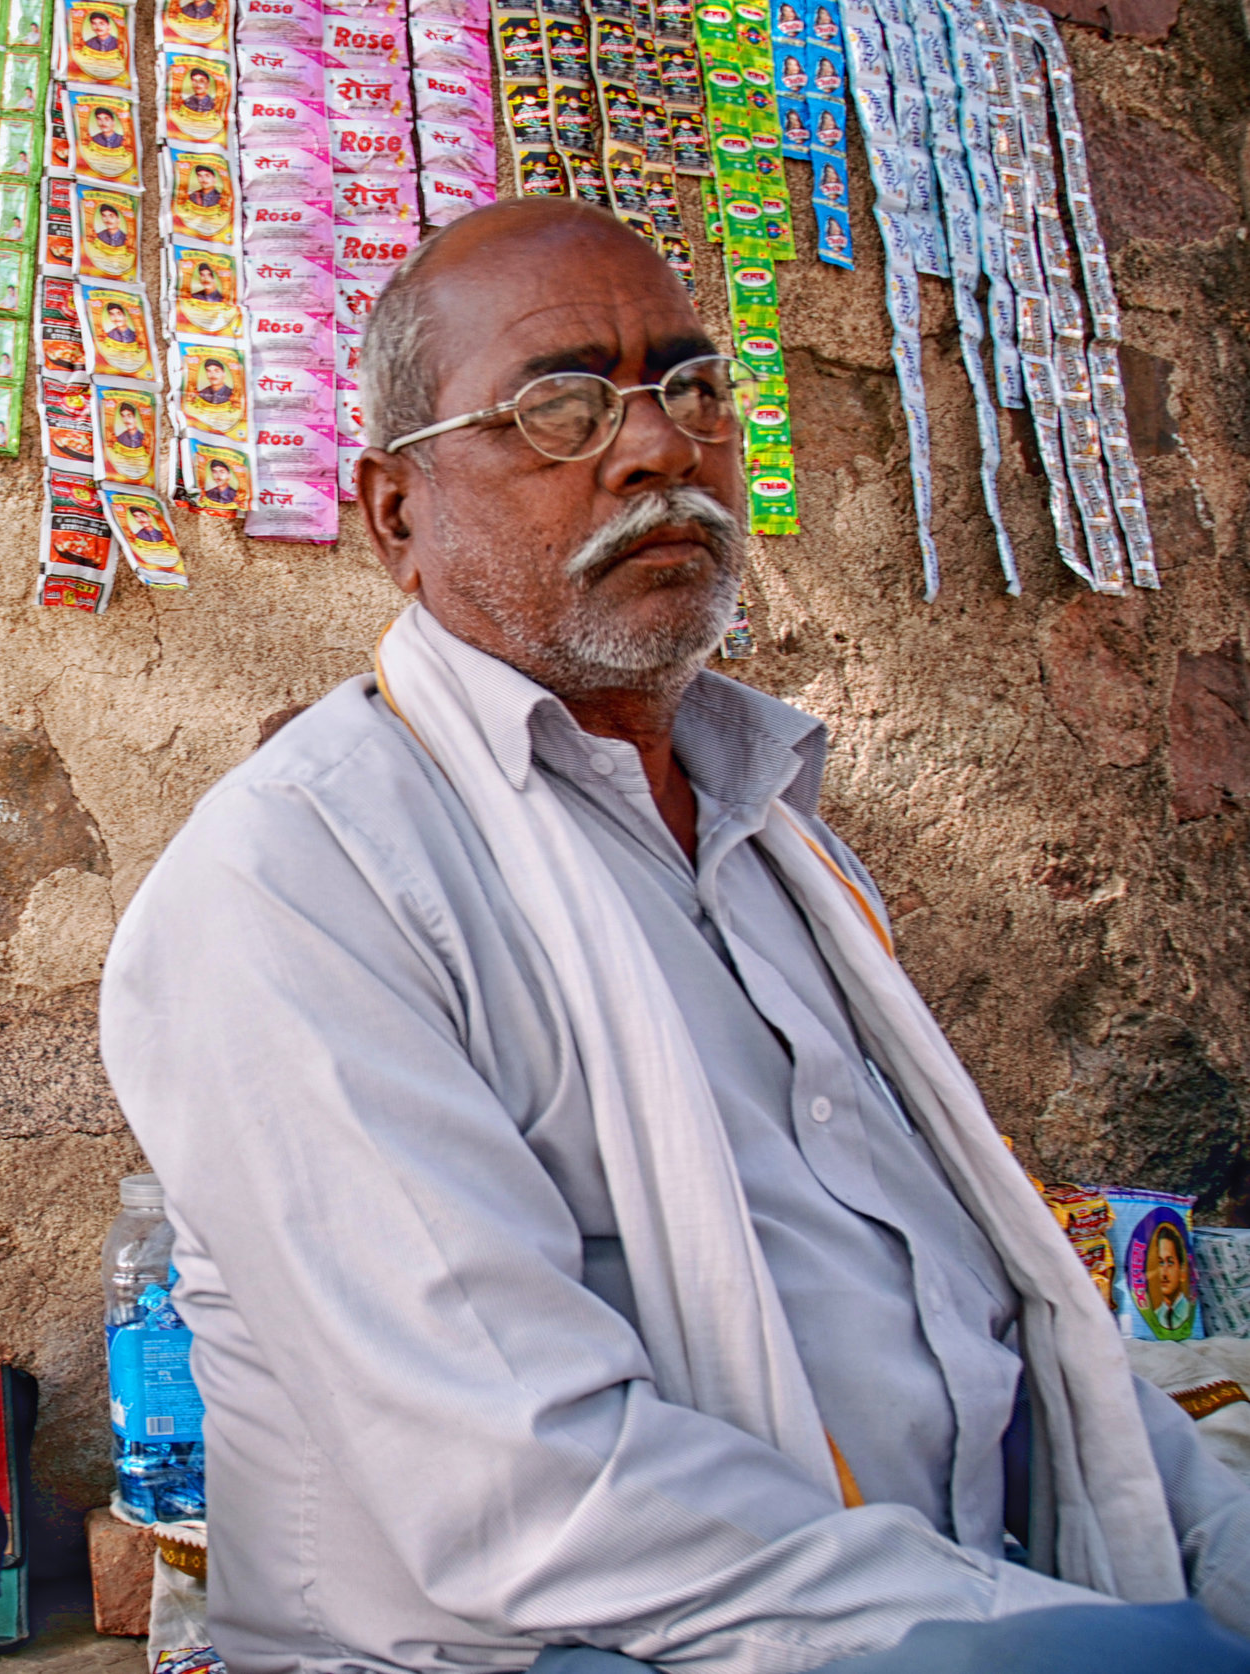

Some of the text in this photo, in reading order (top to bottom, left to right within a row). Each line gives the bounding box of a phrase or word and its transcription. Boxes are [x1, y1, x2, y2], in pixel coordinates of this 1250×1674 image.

[248, 0, 294, 14] Rose
[334, 26, 396, 50] Rose
[250, 53, 285, 70] रोज़
[337, 78, 393, 106] रोज़
[427, 78, 467, 96] Rose
[252, 103, 296, 119] Rose
[340, 131, 402, 153] Rose
[254, 156, 290, 172] रोज़
[342, 182, 399, 211] रोज़
[434, 181, 474, 200] Rose
[255, 208, 302, 223] Rose
[343, 236, 408, 260] Rose
[256, 264, 292, 281] रोज़
[257, 318, 304, 334] Rose
[257, 375, 294, 395] रोज़
[257, 430, 305, 447] Rose
[258, 488, 294, 509] रोज़
